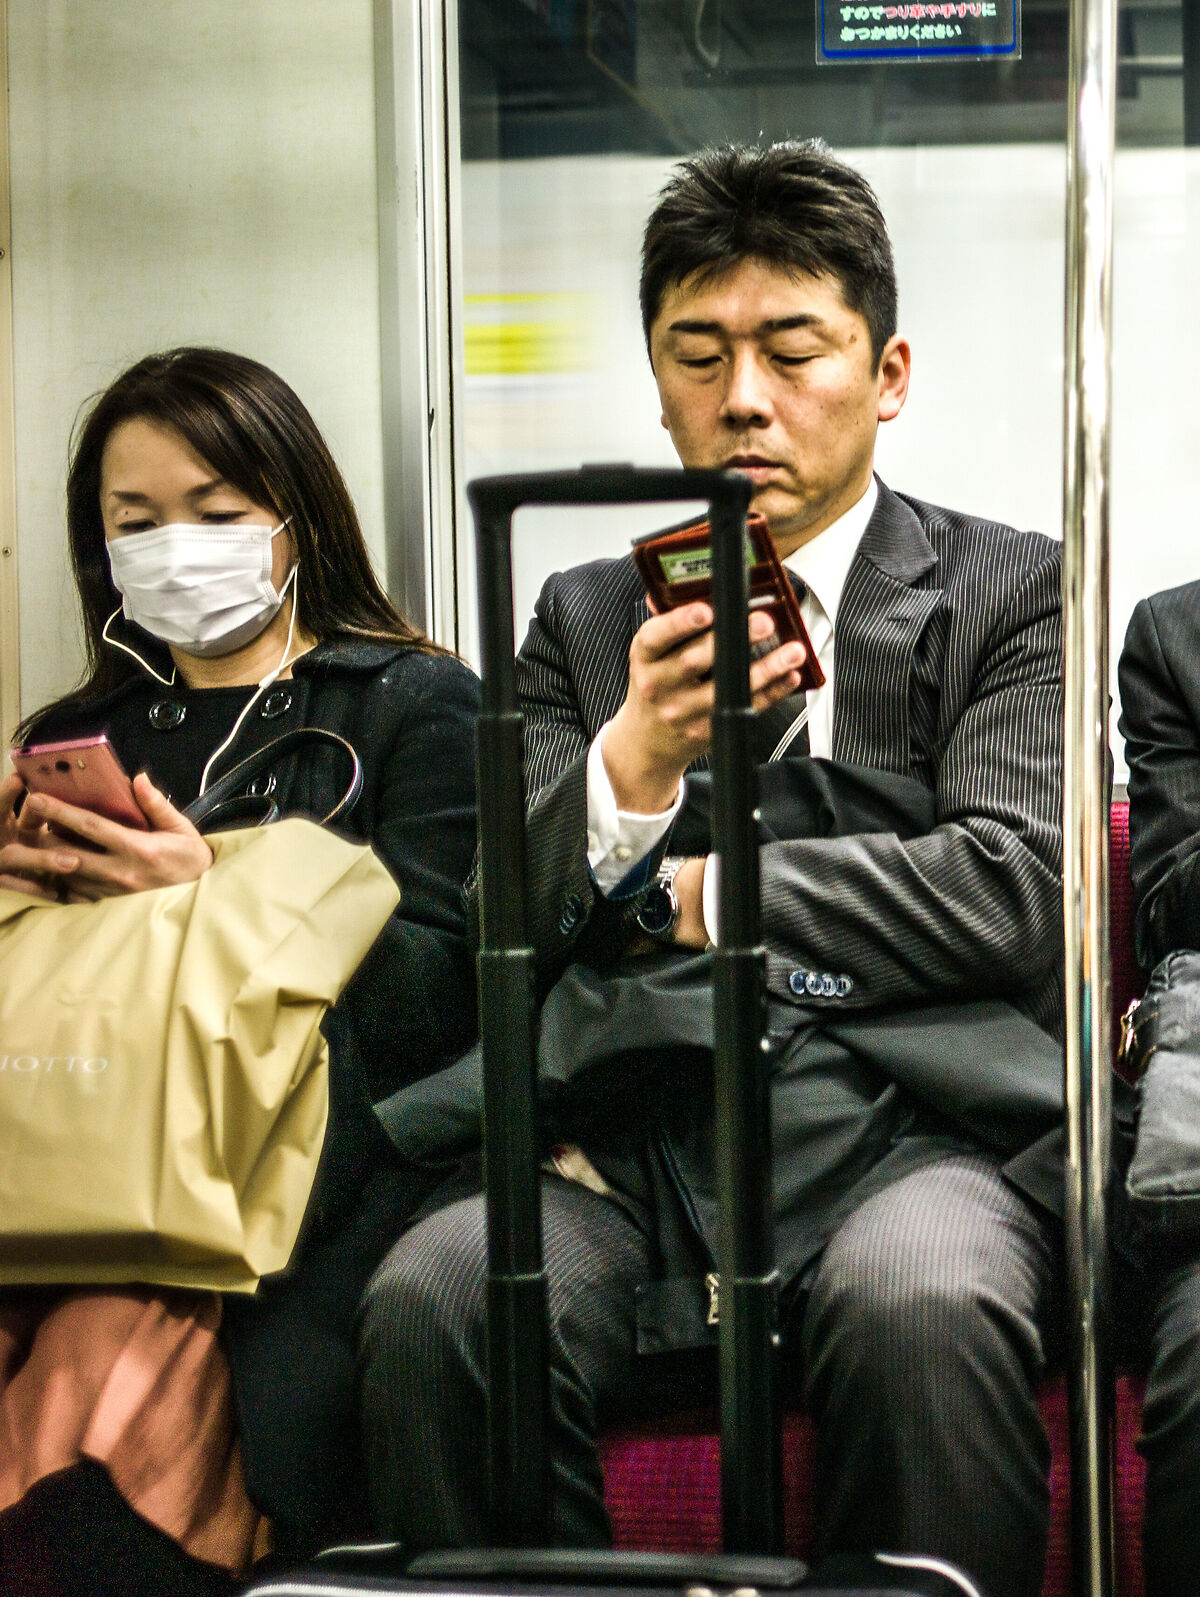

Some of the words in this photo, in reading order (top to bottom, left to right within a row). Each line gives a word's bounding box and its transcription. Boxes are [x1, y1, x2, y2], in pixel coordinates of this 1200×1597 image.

[840, 24, 962, 42] おつかまりください
